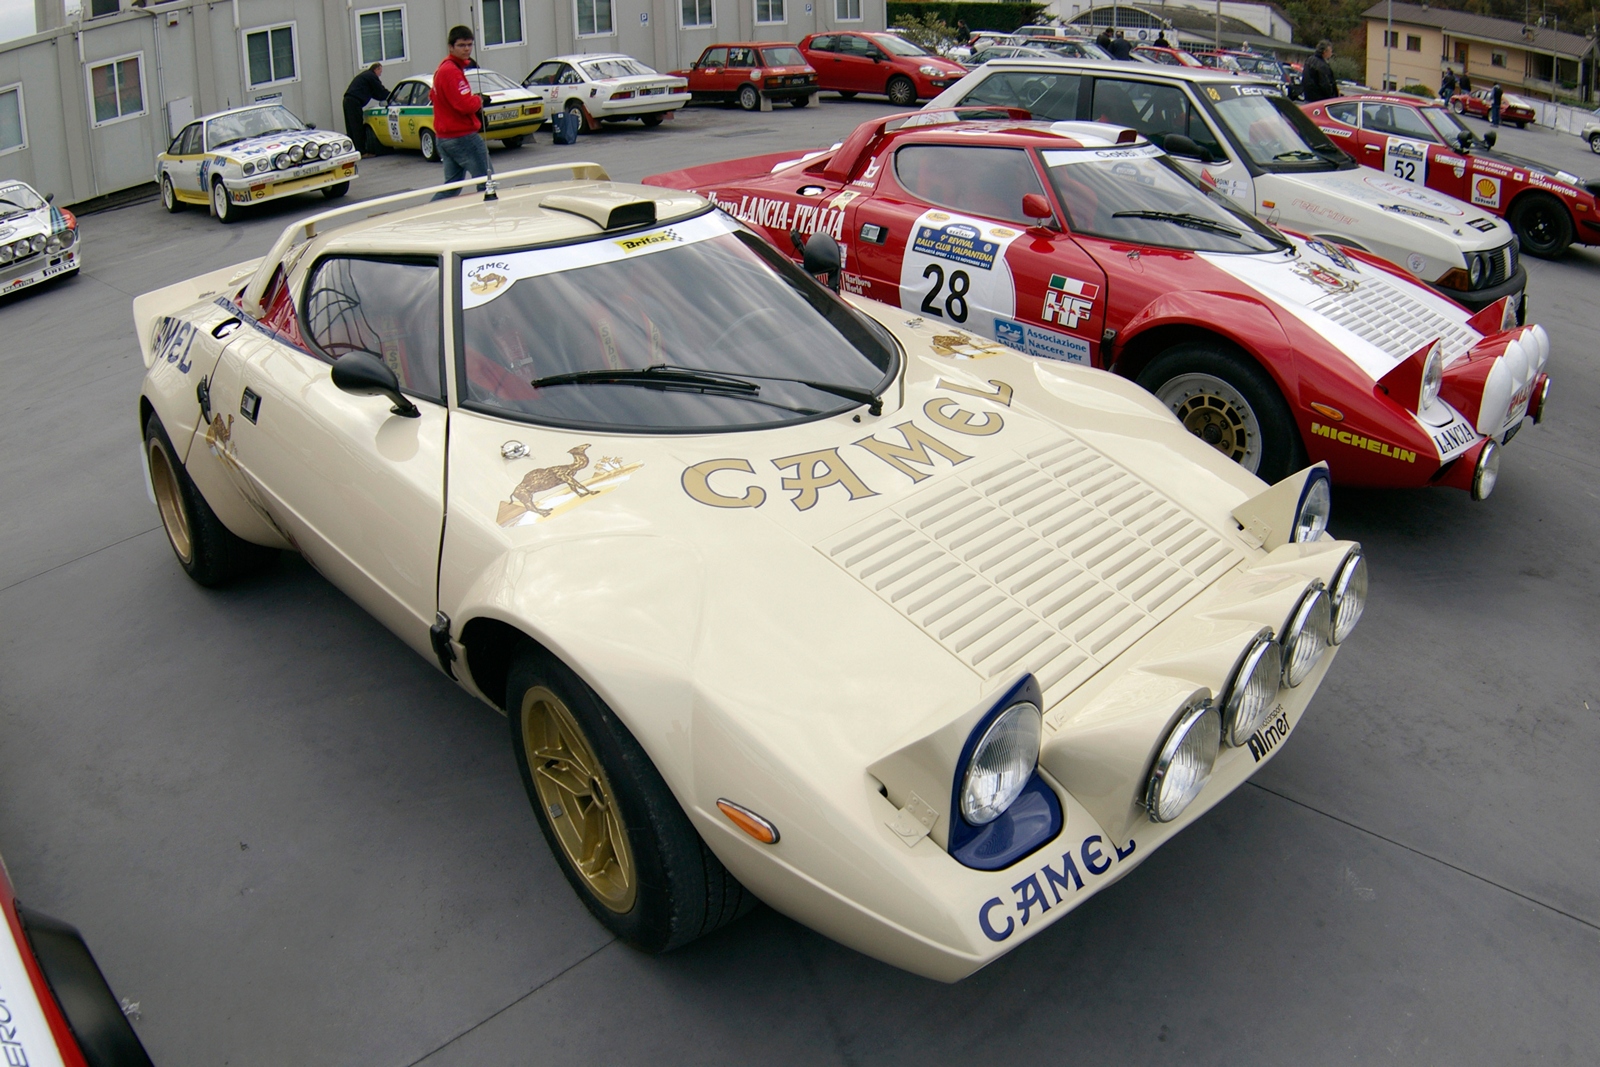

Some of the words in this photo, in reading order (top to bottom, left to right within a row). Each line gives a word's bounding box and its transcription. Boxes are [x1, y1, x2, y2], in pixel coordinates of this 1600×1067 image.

[1393, 160, 1416, 183] 52
[228, 189, 253, 203] Mobil
[1528, 178, 1552, 190] NISSAN
[1551, 183, 1578, 198] MOTORS
[1474, 196, 1497, 207] Shell
[739, 195, 846, 241] LANCIA-ITALIA
[622, 233, 669, 251] Britax
[916, 237, 936, 247] RALLY
[935, 243, 951, 252] CLUB
[952, 245, 994, 262] VALPANTENA
[948, 236, 974, 249] REVIVAL
[467, 262, 511, 278] CAMEL
[845, 272, 872, 288] Marlboro
[845, 282, 863, 295] World
[920, 264, 971, 324] 28
[1041, 289, 1093, 329] HF
[1027, 328, 1088, 353] Associazione
[1028, 339, 1065, 356] Nascere
[1067, 351, 1083, 362] per
[680, 379, 1014, 512] CAMEL
[1310, 421, 1417, 464] MICHELIN
[1432, 422, 1475, 455] LANCIA
